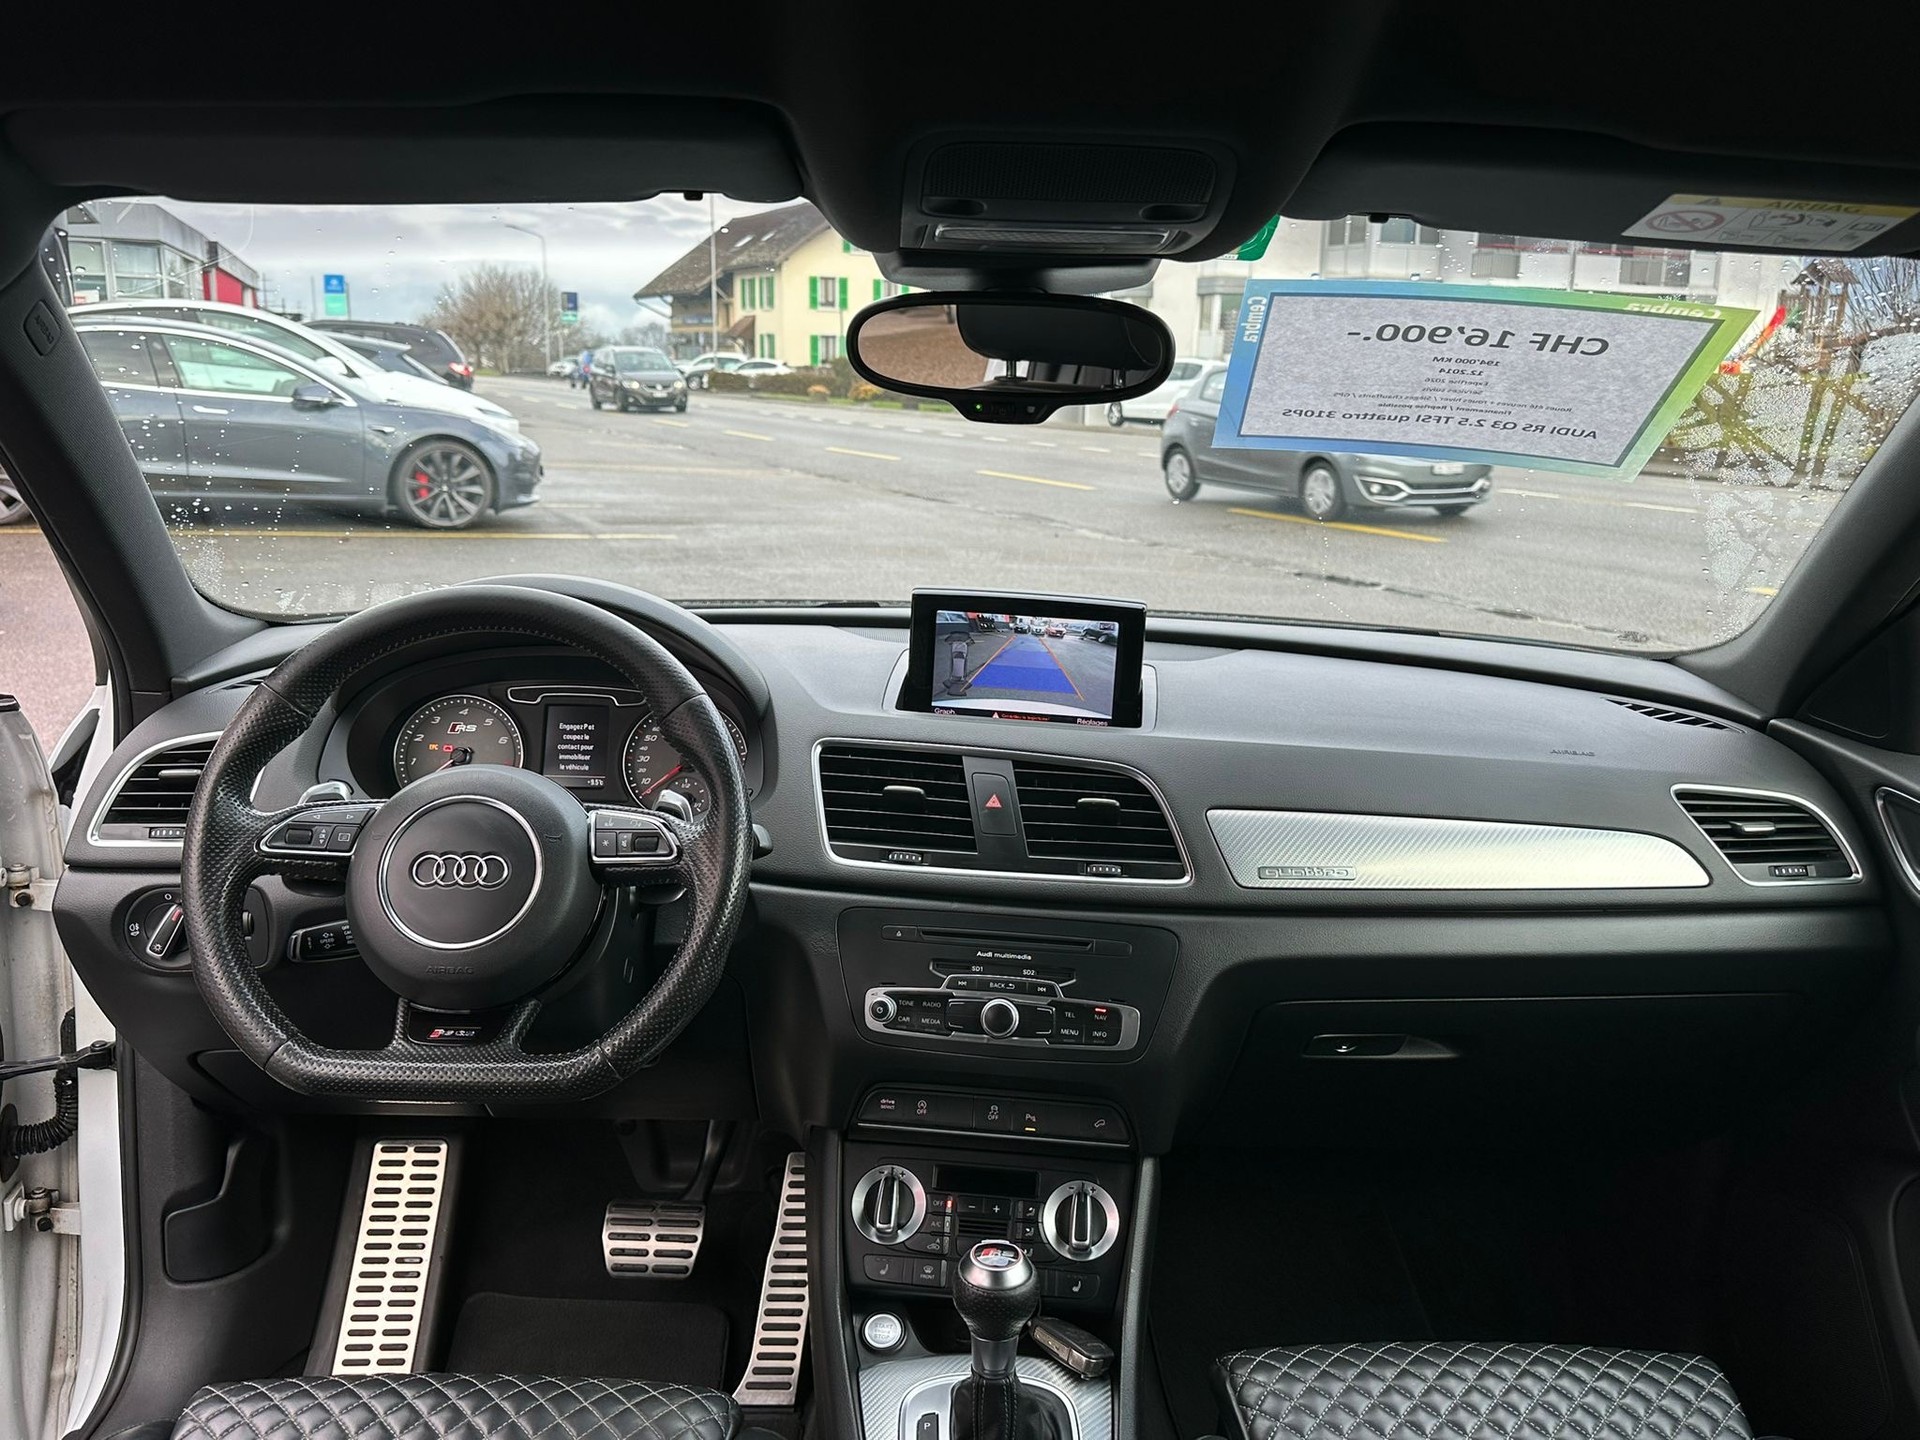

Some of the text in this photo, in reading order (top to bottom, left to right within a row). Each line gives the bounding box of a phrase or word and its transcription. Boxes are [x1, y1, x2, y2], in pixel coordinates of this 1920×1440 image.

[1763, 201, 1862, 213] AIRBAG
[458, 708, 469, 716] 4
[934, 707, 955, 716] Graph
[430, 716, 441, 724] 3
[483, 718, 494, 726] 5
[1076, 718, 1108, 727] Réglages
[559, 722, 583, 731] Engagez
[413, 733, 425, 742] 2
[497, 736, 509, 744] 6
[410, 757, 417, 765] 1
[1264, 867, 1350, 878] quattro
[994, 952, 1032, 961] multimedia
[425, 965, 475, 975] AIRBAG
[1064, 1011, 1076, 1019] TEL
[921, 1017, 941, 1025] MEDIA
[1060, 1028, 1079, 1036] MENU
[1092, 1030, 1108, 1038] INFO
[923, 1422, 931, 1430] P
